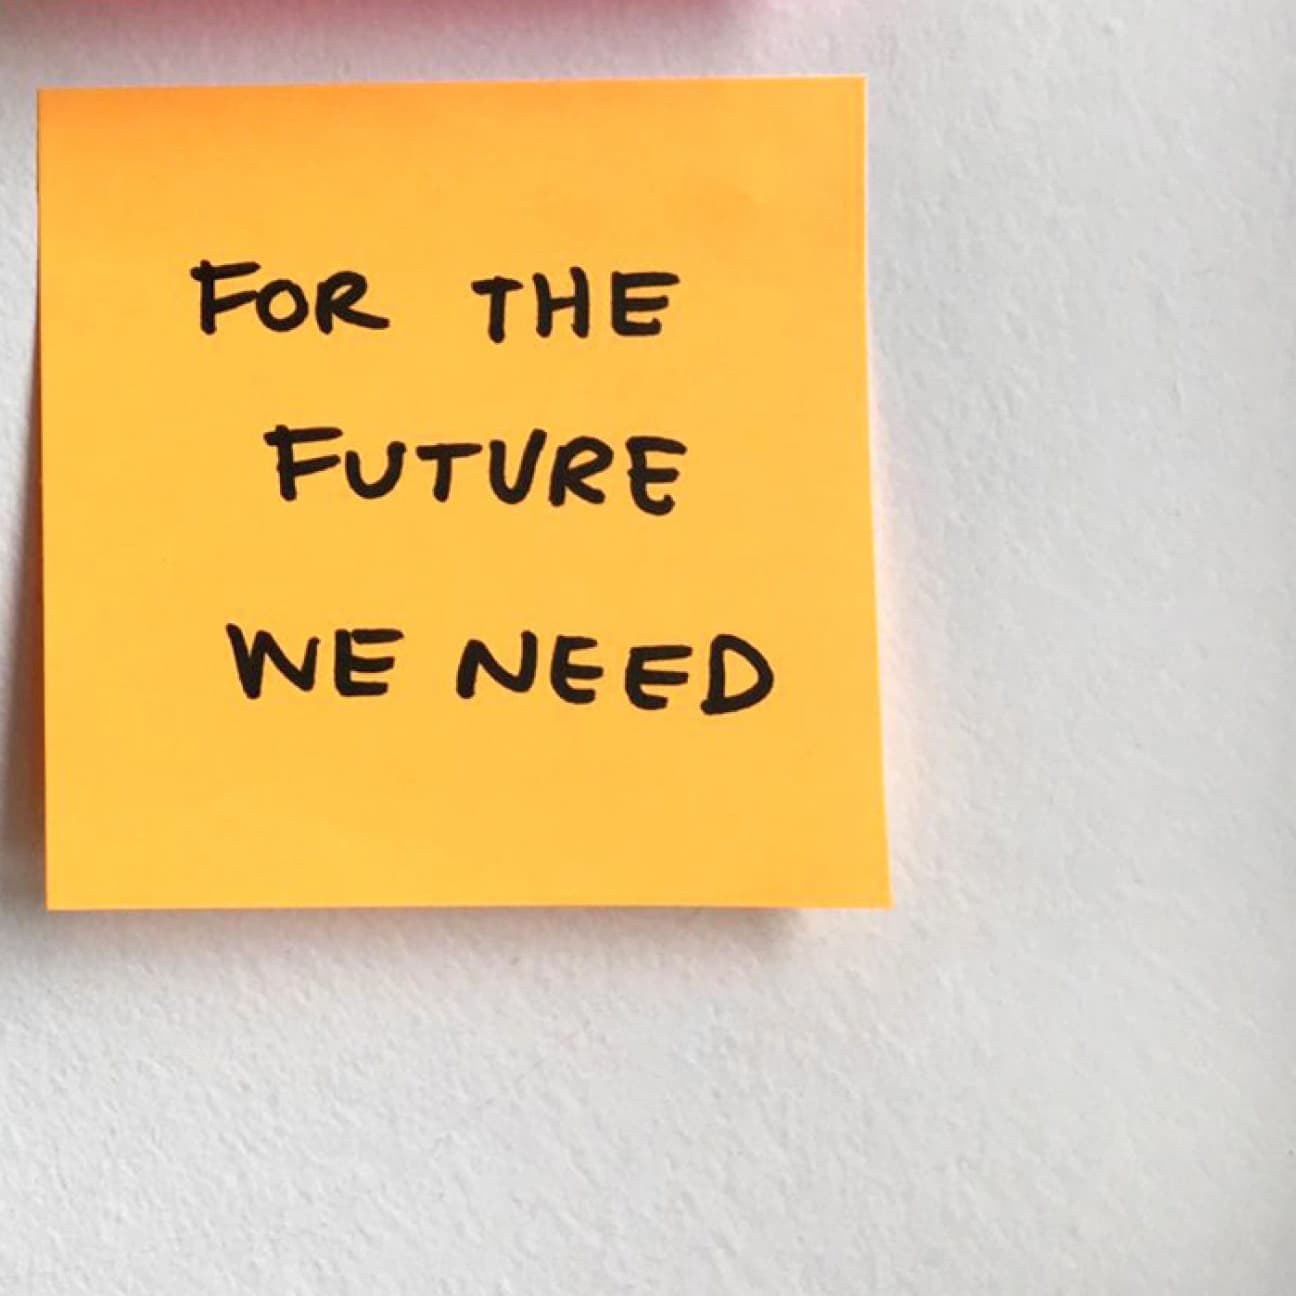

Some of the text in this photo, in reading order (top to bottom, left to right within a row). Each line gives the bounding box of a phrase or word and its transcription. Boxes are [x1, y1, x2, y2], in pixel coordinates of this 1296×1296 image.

[190, 259, 680, 344] FOR THE
[263, 424, 687, 515] FUTURE
[225, 623, 775, 716] WE NEED
